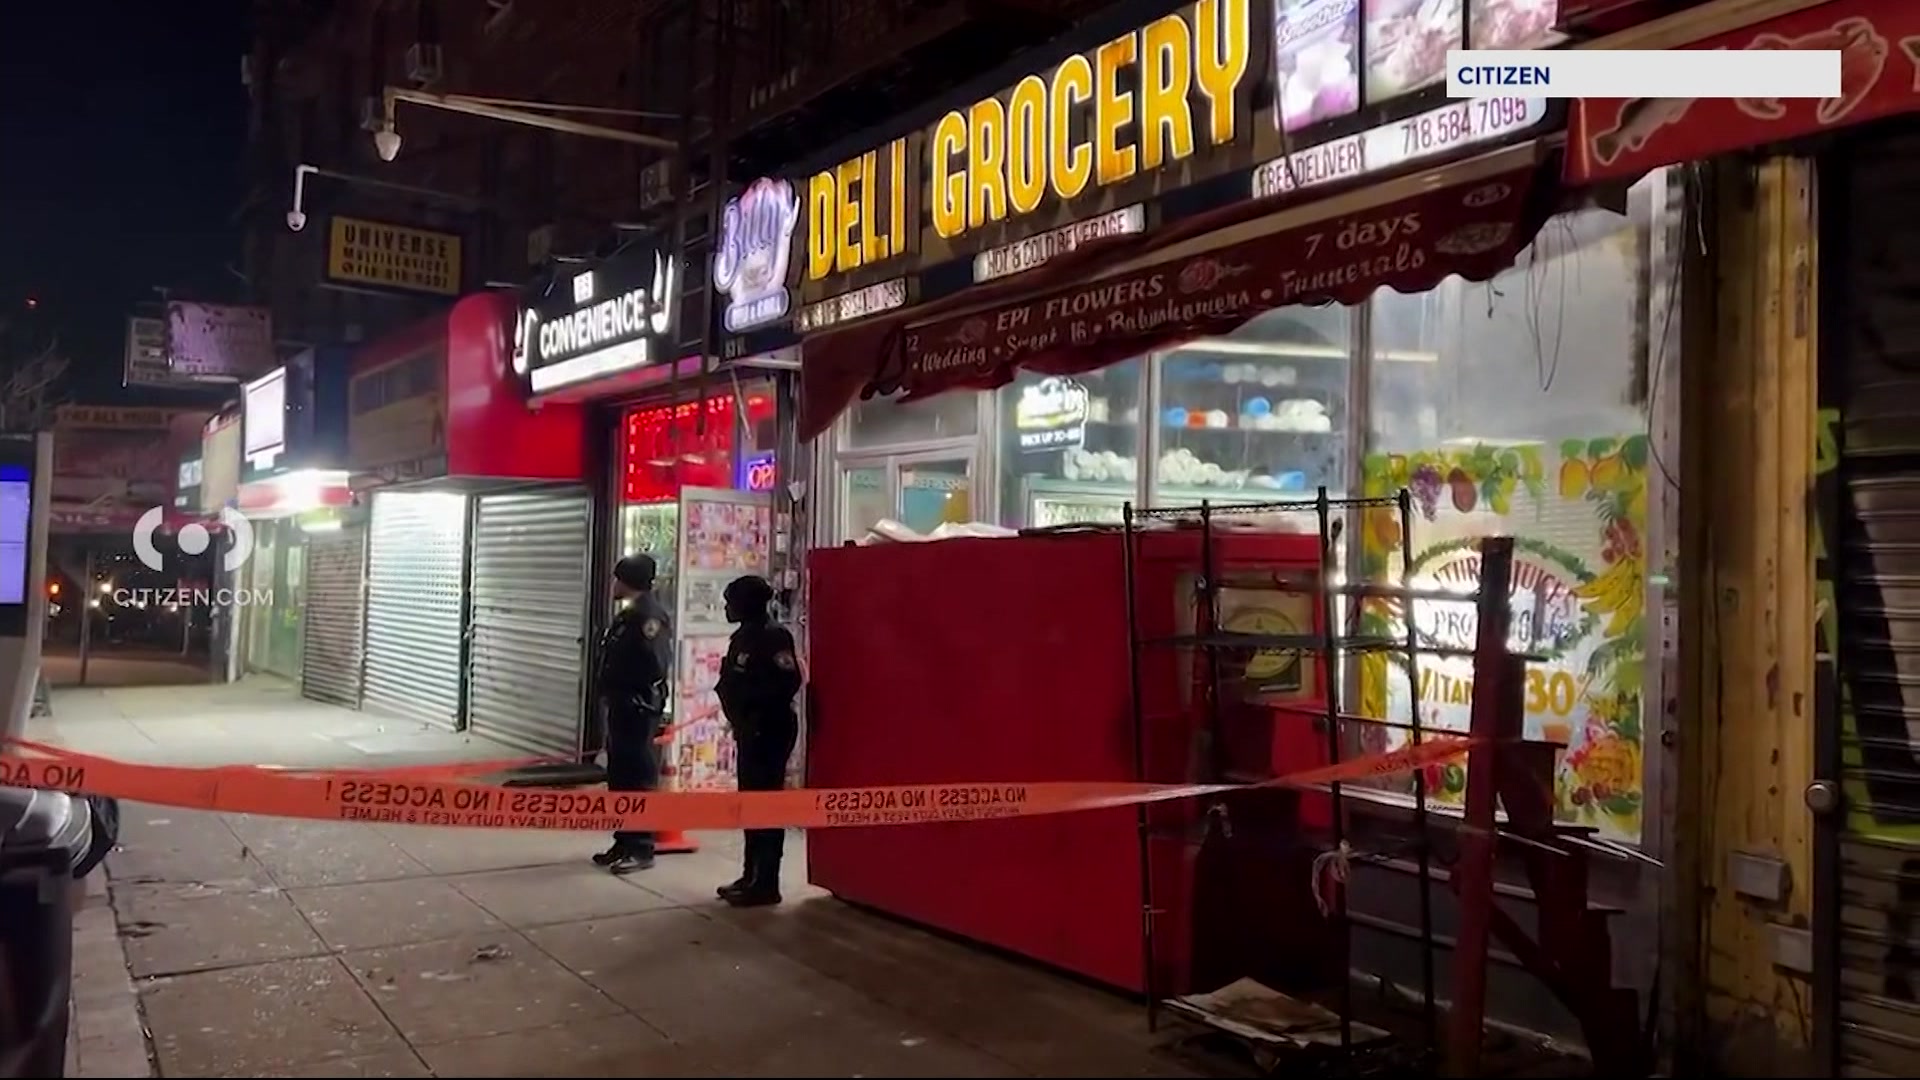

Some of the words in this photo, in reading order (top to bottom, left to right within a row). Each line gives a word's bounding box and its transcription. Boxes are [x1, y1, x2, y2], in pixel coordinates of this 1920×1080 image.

[808, 137, 906, 281] DELI
[931, 0, 1250, 239] GROCERY
[1296, 134, 1366, 187] DELIVERY
[1401, 97, 1528, 155] 718.584.7095
[344, 223, 448, 259] UNIVERSE
[1305, 232, 1325, 260] 7
[1335, 211, 1422, 250] days
[539, 287, 646, 360] CONVENIENCE
[996, 305, 1033, 332] EPI
[1045, 274, 1165, 319] FLOWERS
